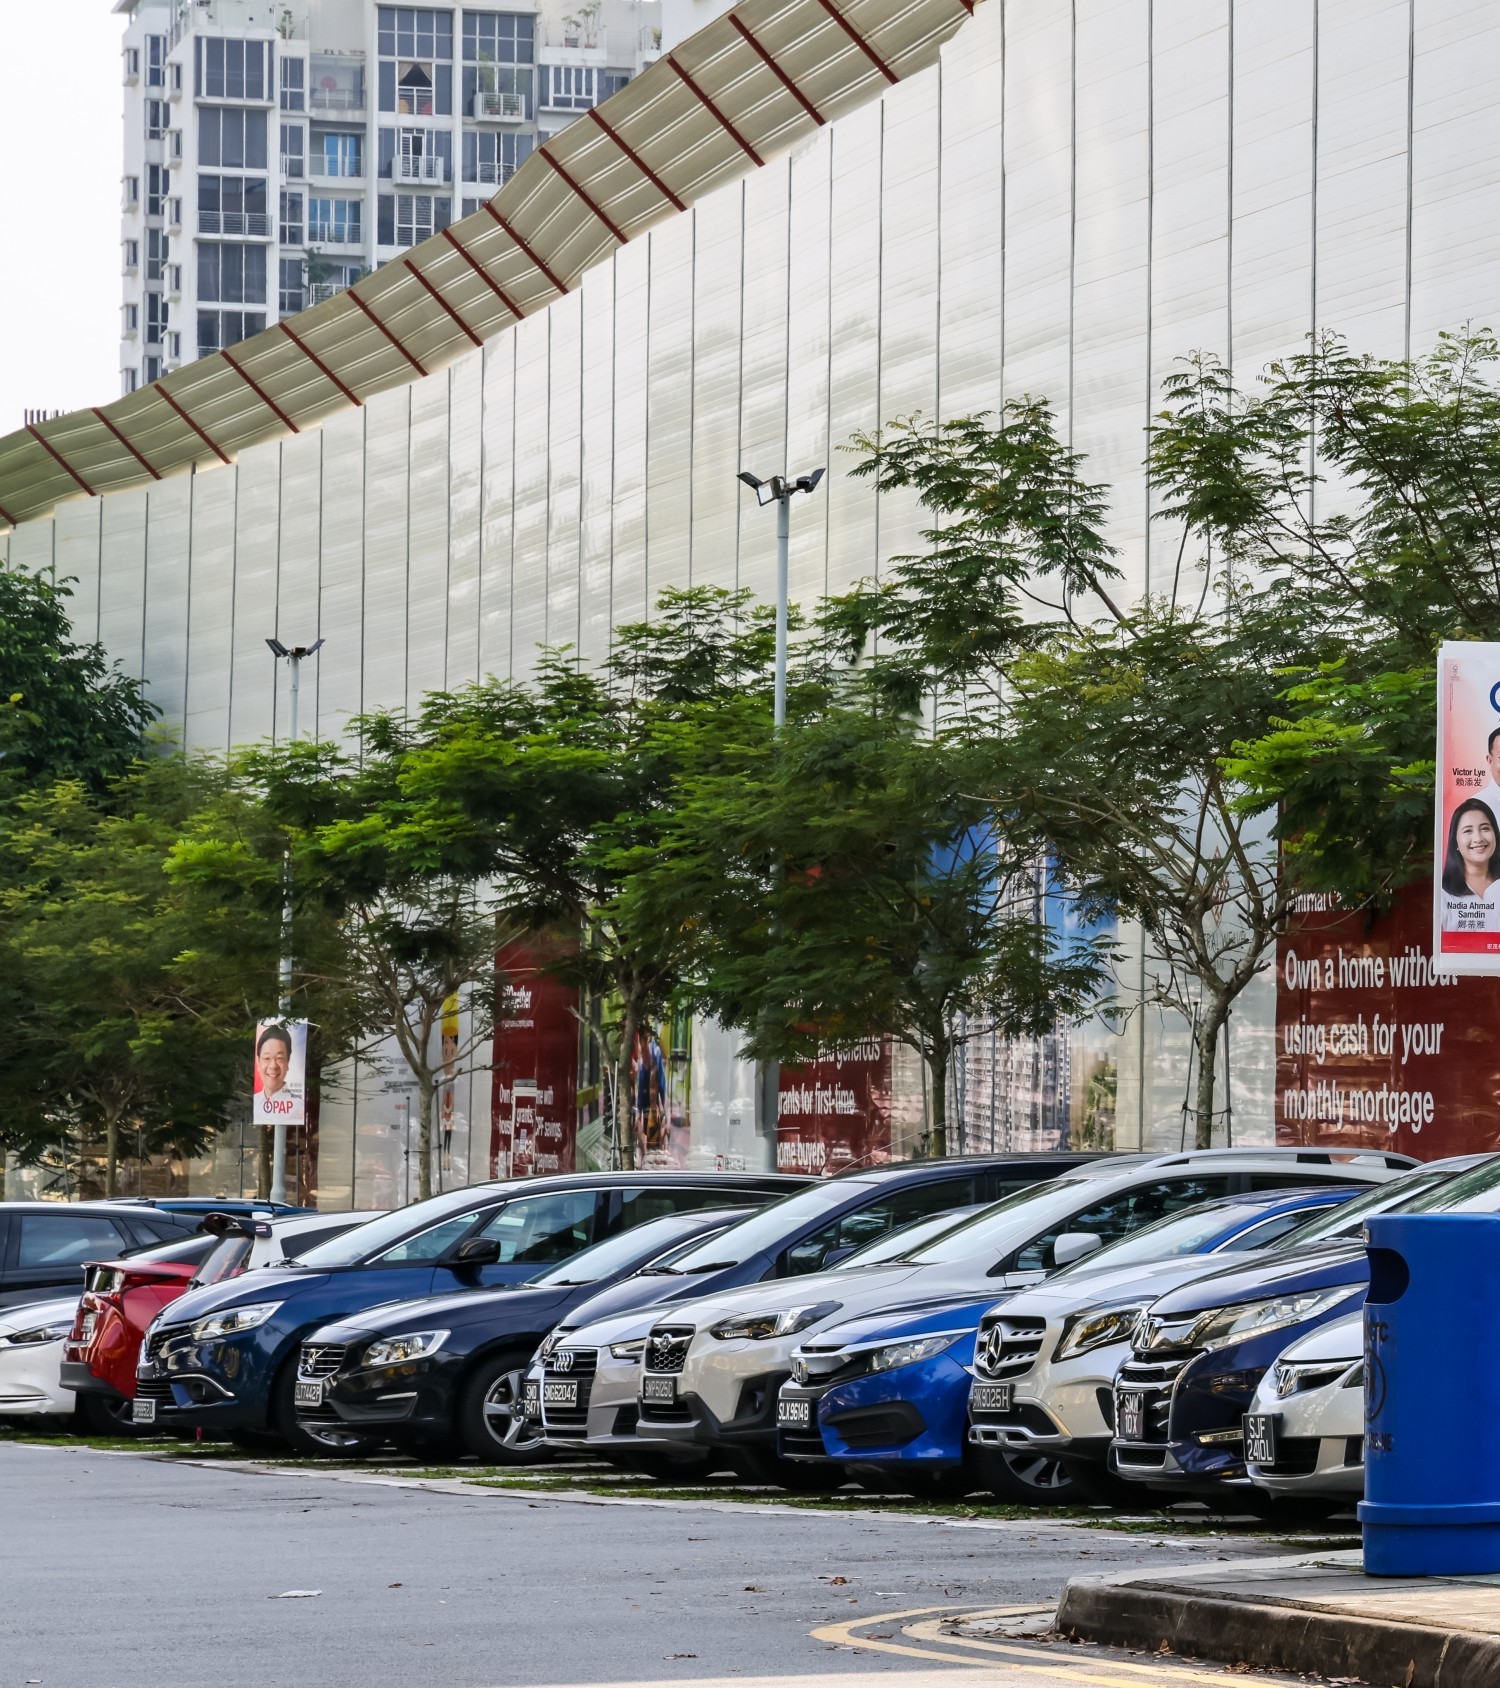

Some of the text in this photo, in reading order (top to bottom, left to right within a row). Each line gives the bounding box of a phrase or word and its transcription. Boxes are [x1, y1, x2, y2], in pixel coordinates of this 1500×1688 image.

[1452, 768, 1486, 778] Victor Lye
[1447, 901, 1495, 911] Nadia Ahmad
[1457, 911, 1486, 919] Samdin
[1285, 949, 1321, 991] Own
[1325, 957, 1335, 989] a
[1338, 947, 1385, 989] home
[1284, 1013, 1445, 1066] using cash for your
[273, 1101, 293, 1113] PAP
[801, 1082, 814, 1115] for
[815, 1081, 855, 1115] first-time
[1283, 1080, 1435, 1134] monthly mortgage
[1125, 1414, 1138, 1434] 10X
[1248, 1417, 1266, 1439] SJF
[1247, 1439, 1273, 1461] 2410L
